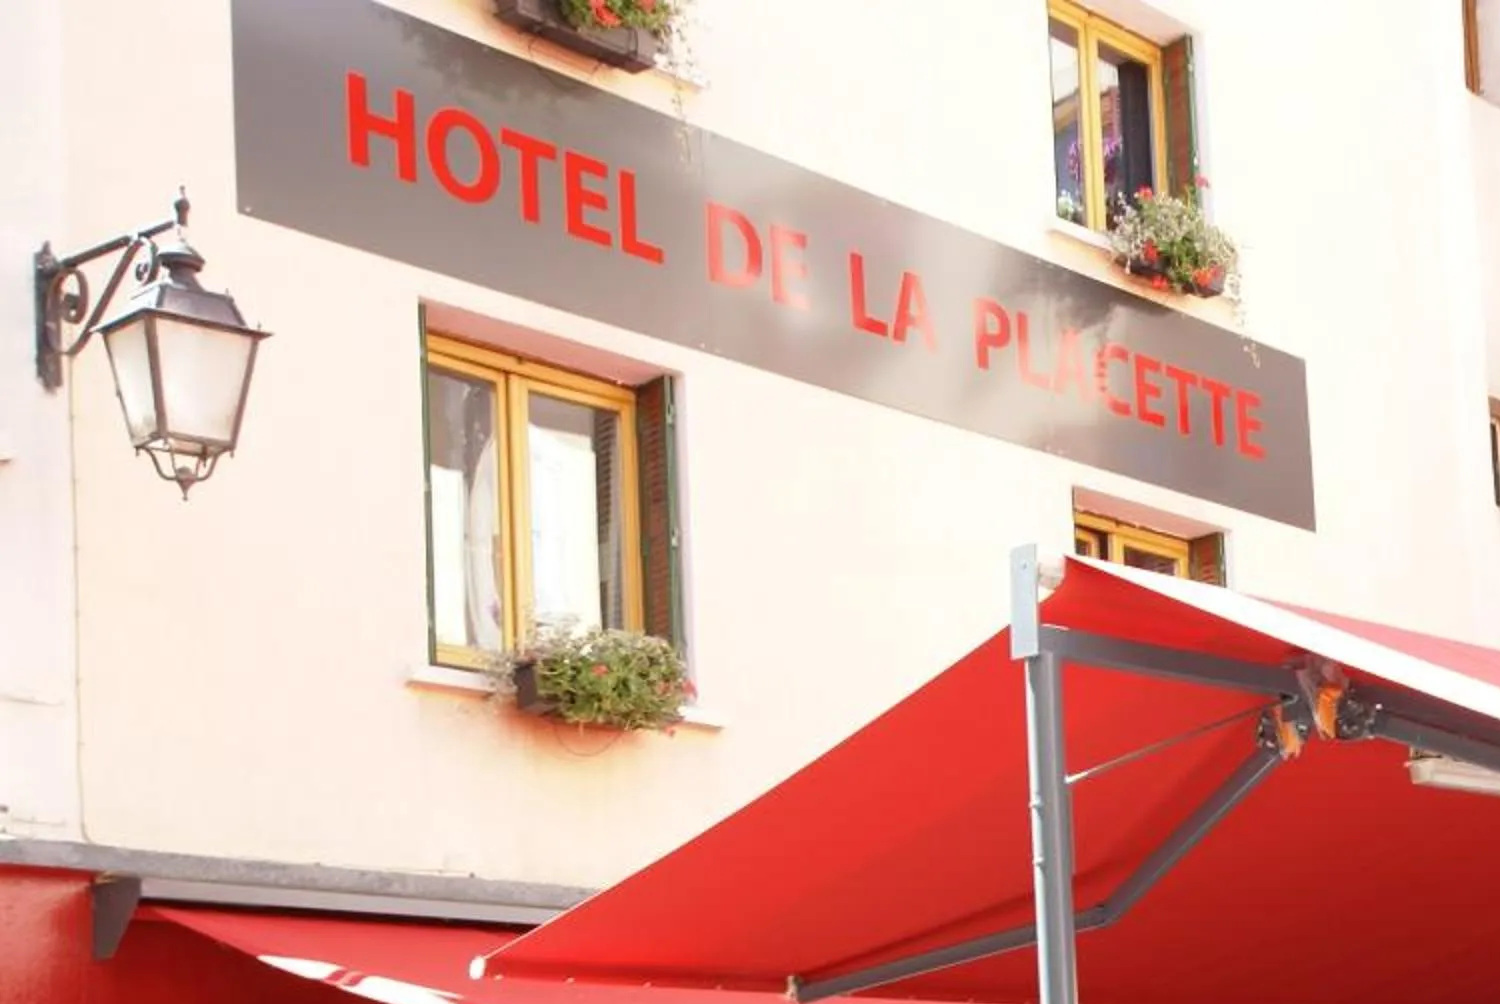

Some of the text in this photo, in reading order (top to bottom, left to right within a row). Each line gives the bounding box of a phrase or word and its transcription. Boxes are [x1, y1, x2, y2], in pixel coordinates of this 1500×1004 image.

[345, 71, 1266, 460] HOTEL DE LA PLACETTE
